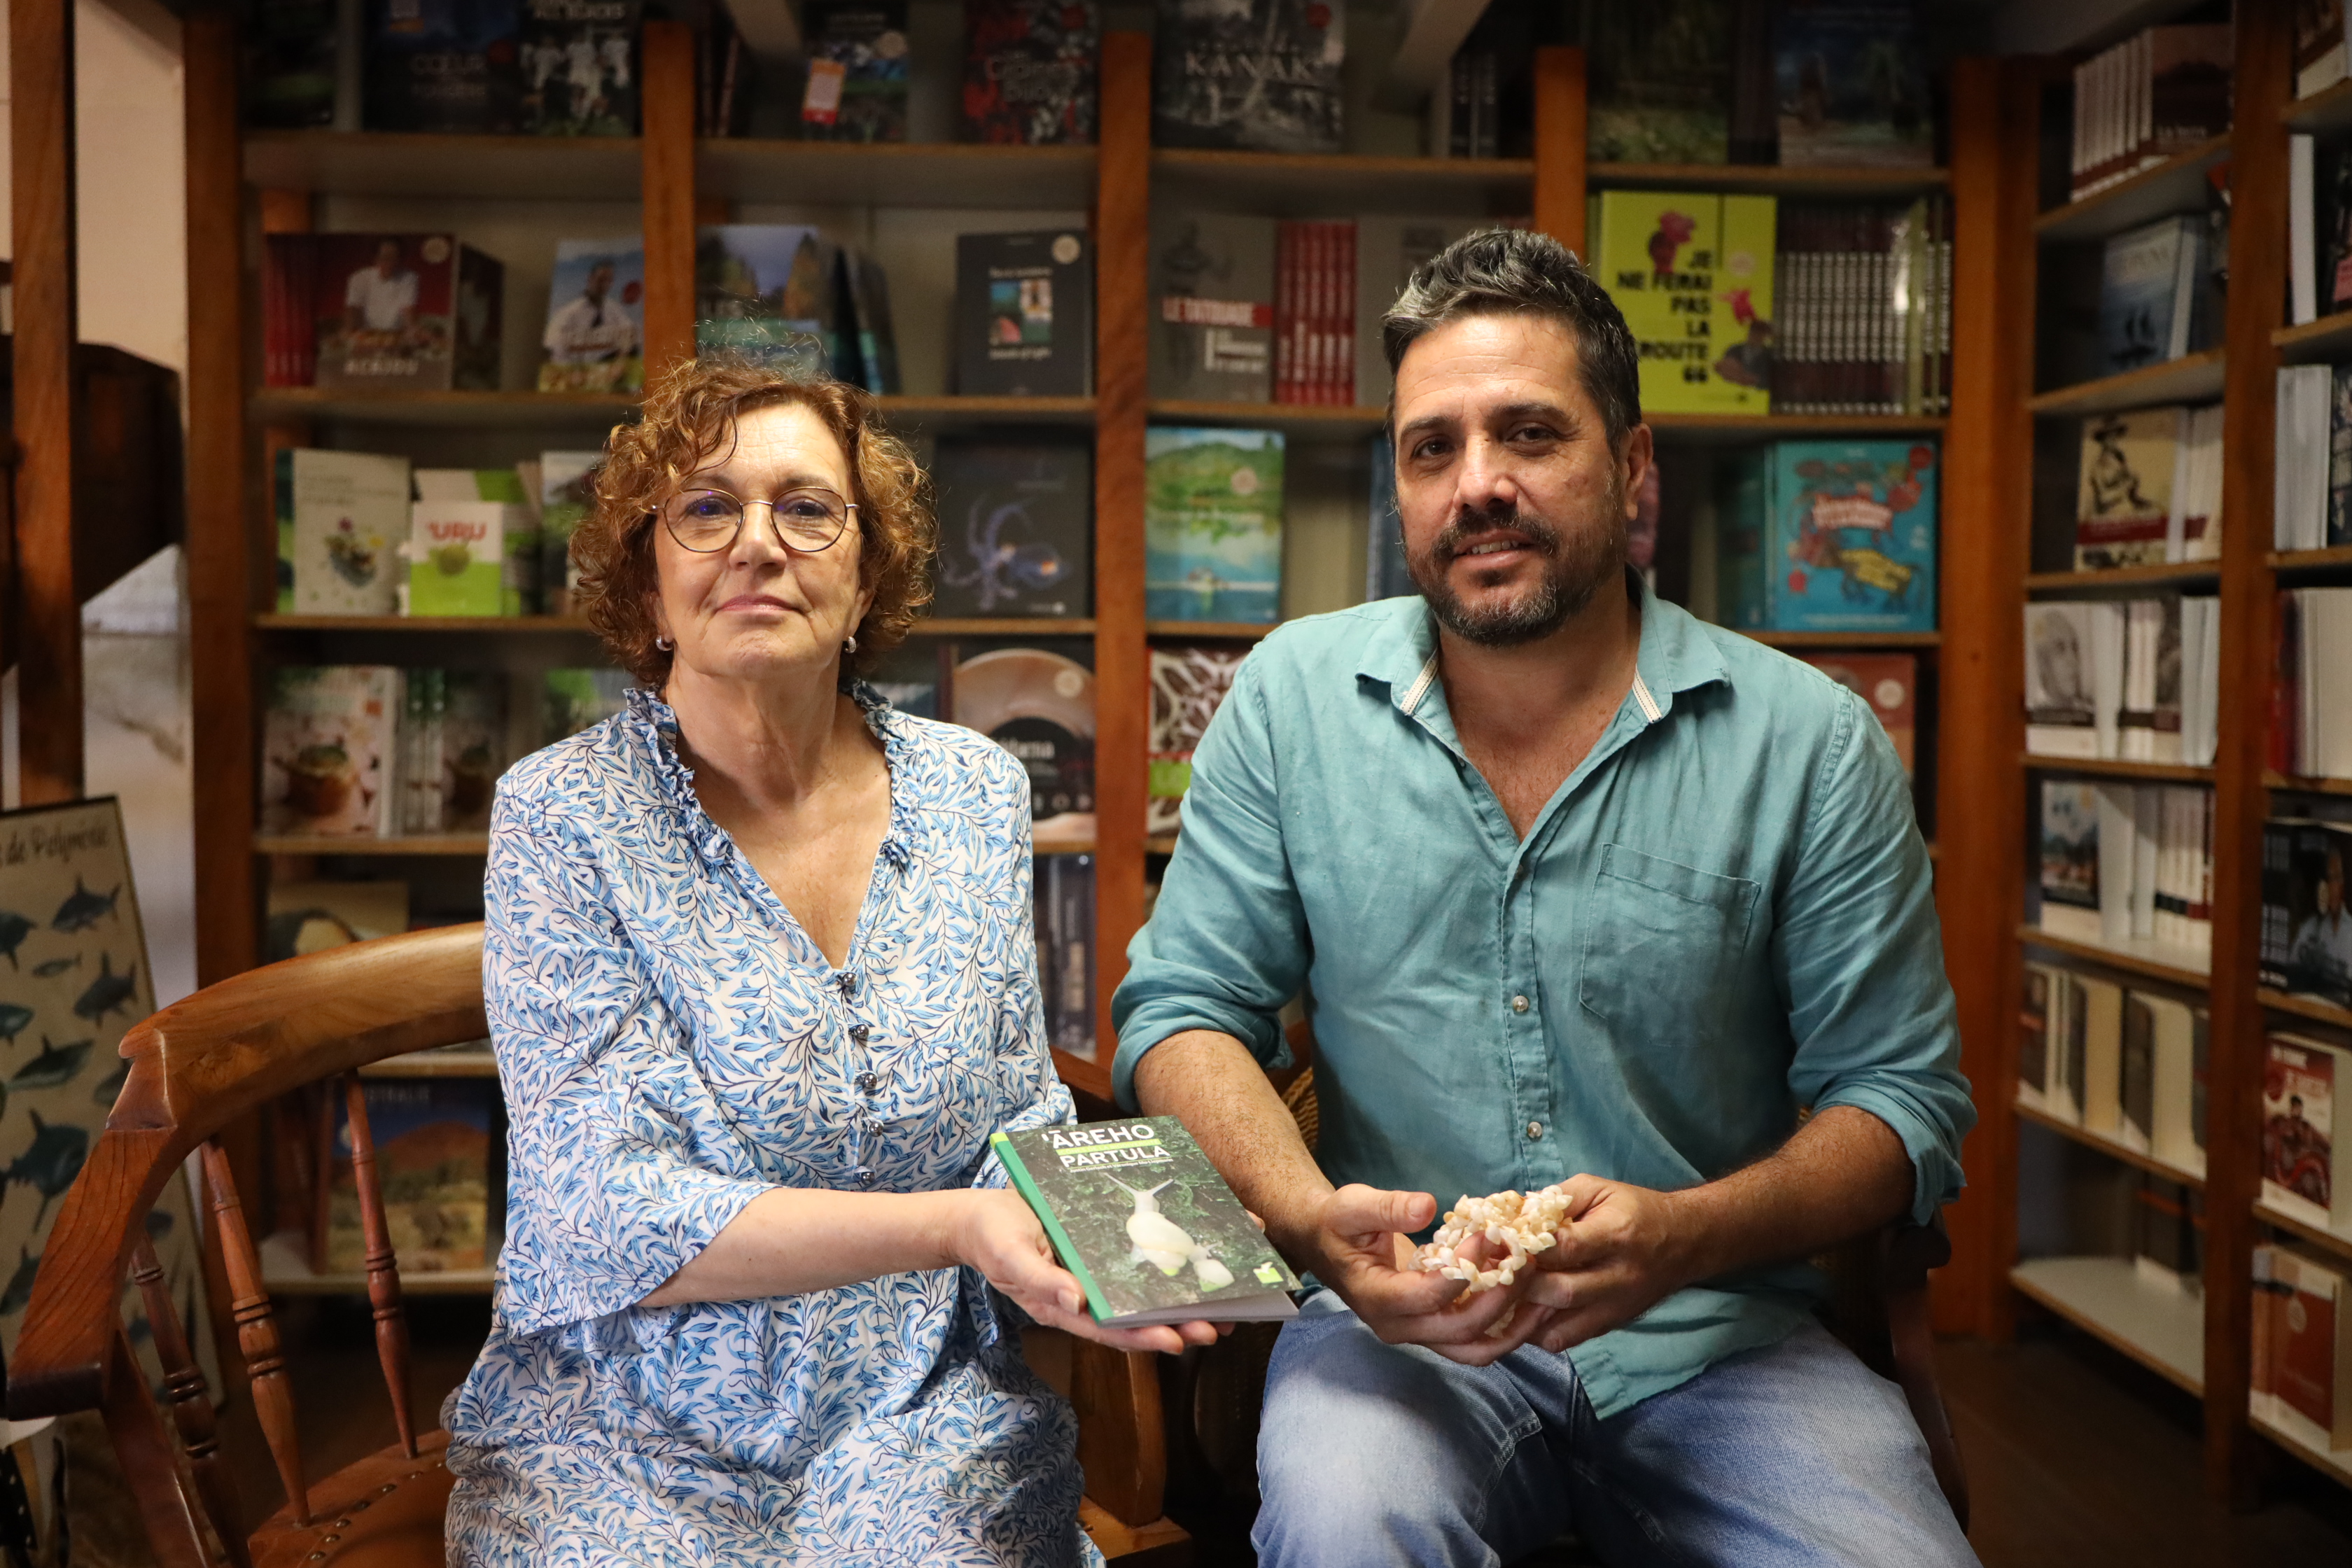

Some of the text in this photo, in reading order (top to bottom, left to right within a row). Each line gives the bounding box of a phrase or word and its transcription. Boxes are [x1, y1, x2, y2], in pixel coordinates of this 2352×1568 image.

[1688, 250, 1712, 269] JE
[1616, 270, 1644, 291] NE
[1670, 295, 1711, 314] PAS
[1685, 319, 1709, 338] LA
[1059, 1145, 1171, 1168] PARTULA
